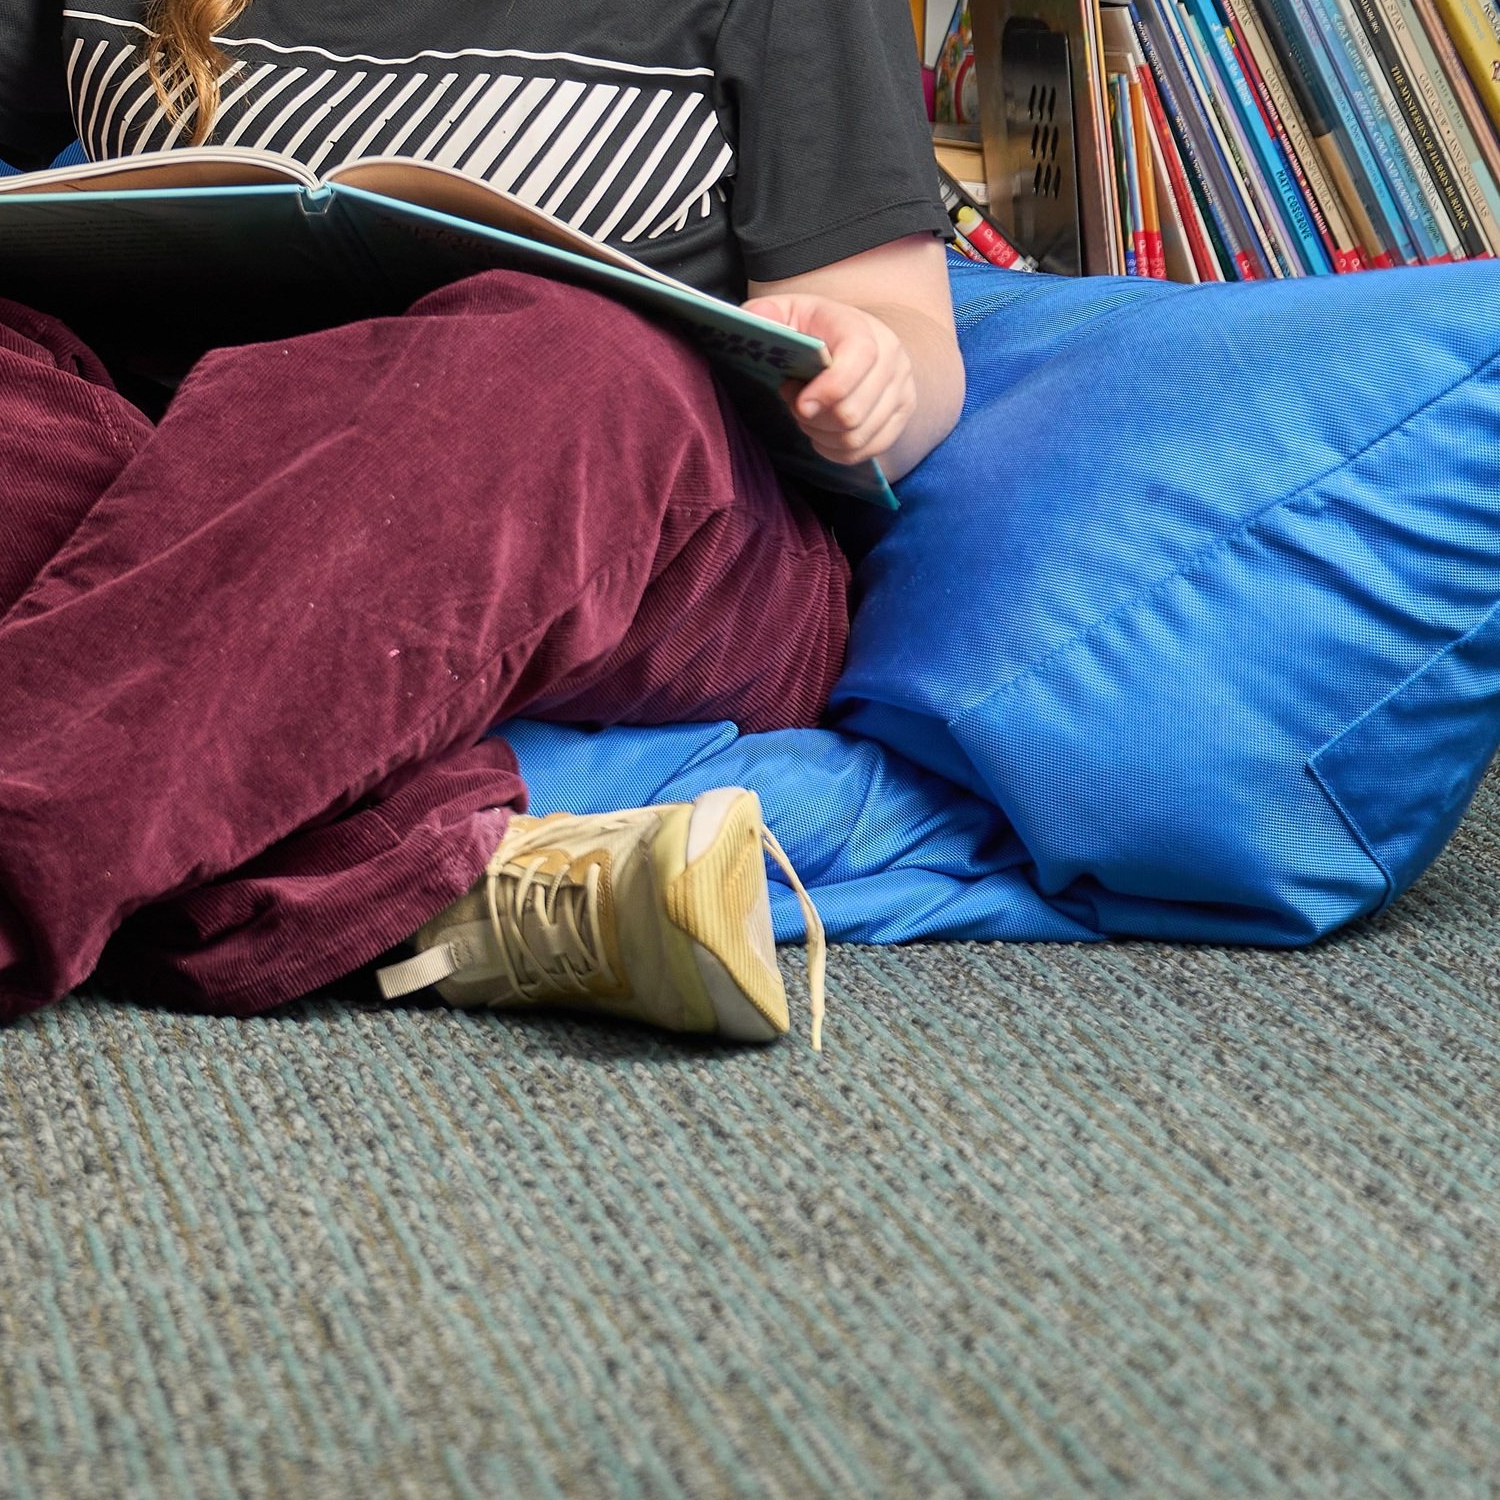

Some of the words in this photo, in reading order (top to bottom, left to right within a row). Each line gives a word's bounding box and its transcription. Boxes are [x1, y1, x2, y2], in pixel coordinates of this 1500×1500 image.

[1275, 169, 1293, 197] MATT
[1287, 195, 1313, 240] COSGROVE
[1399, 84, 1425, 137] MYSTERIES
[1428, 150, 1448, 187] HARRIS
[1443, 185, 1470, 231] BURDICK
